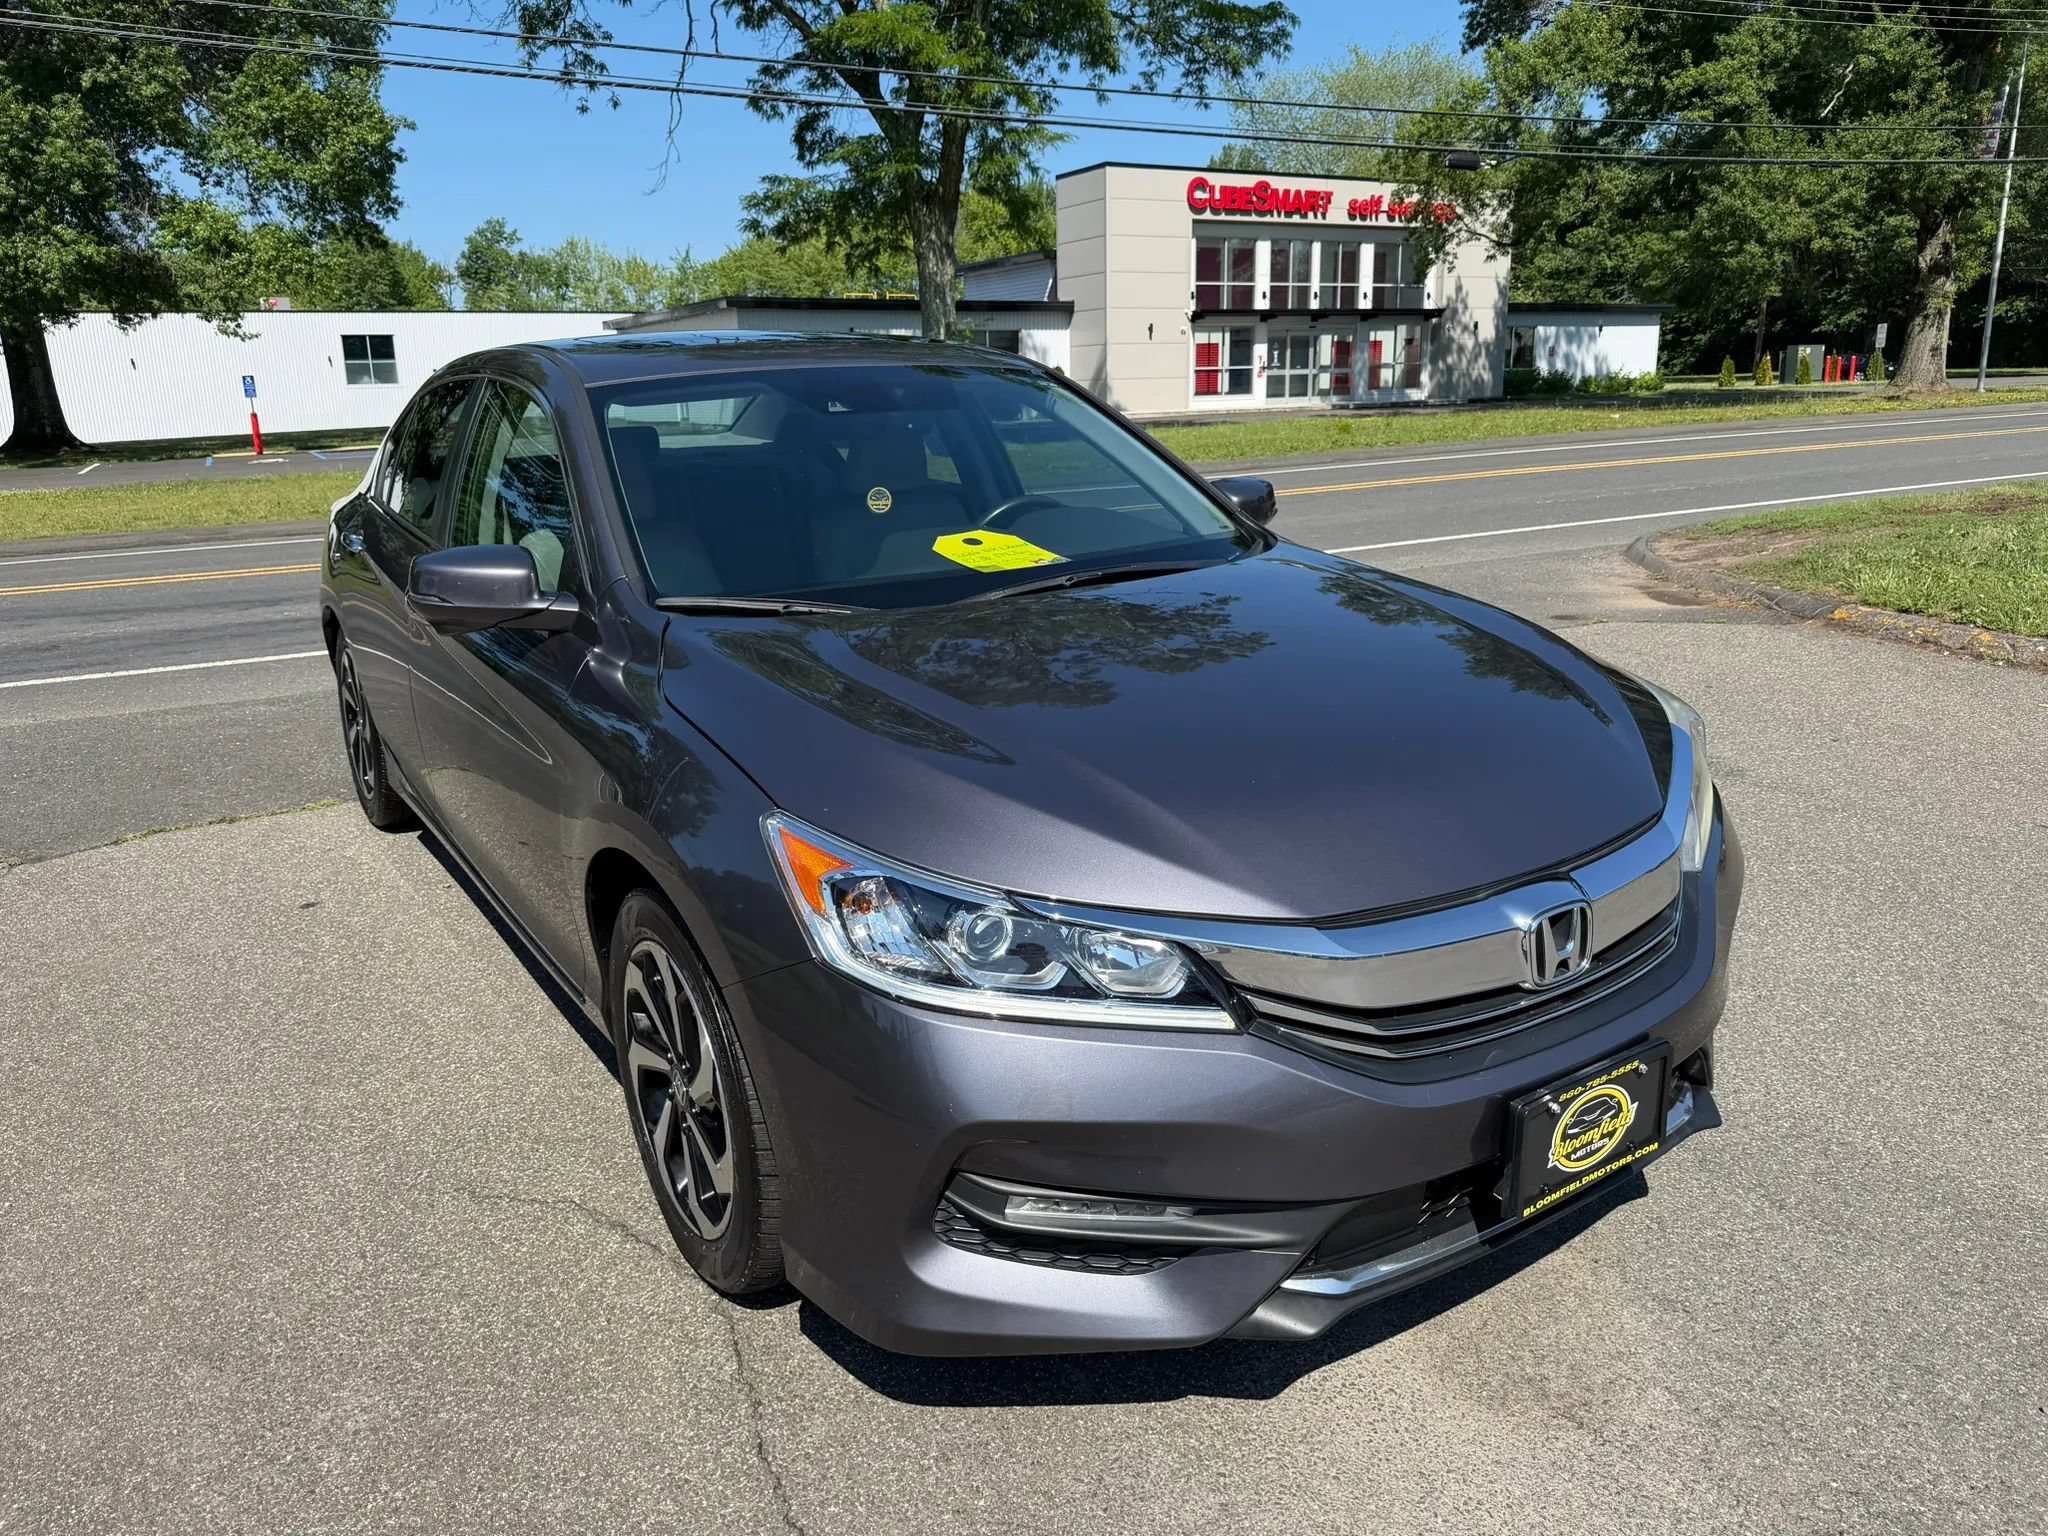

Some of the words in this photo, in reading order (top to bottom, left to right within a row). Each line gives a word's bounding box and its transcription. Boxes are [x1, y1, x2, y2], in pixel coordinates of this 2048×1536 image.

[1348, 194, 1384, 217] self
[1553, 1110, 1633, 1161] Bloomfield
[1570, 1137, 1610, 1161] MOTORS
[1523, 1142, 1659, 1217] BLOOMFIELDMOTORS.COM
